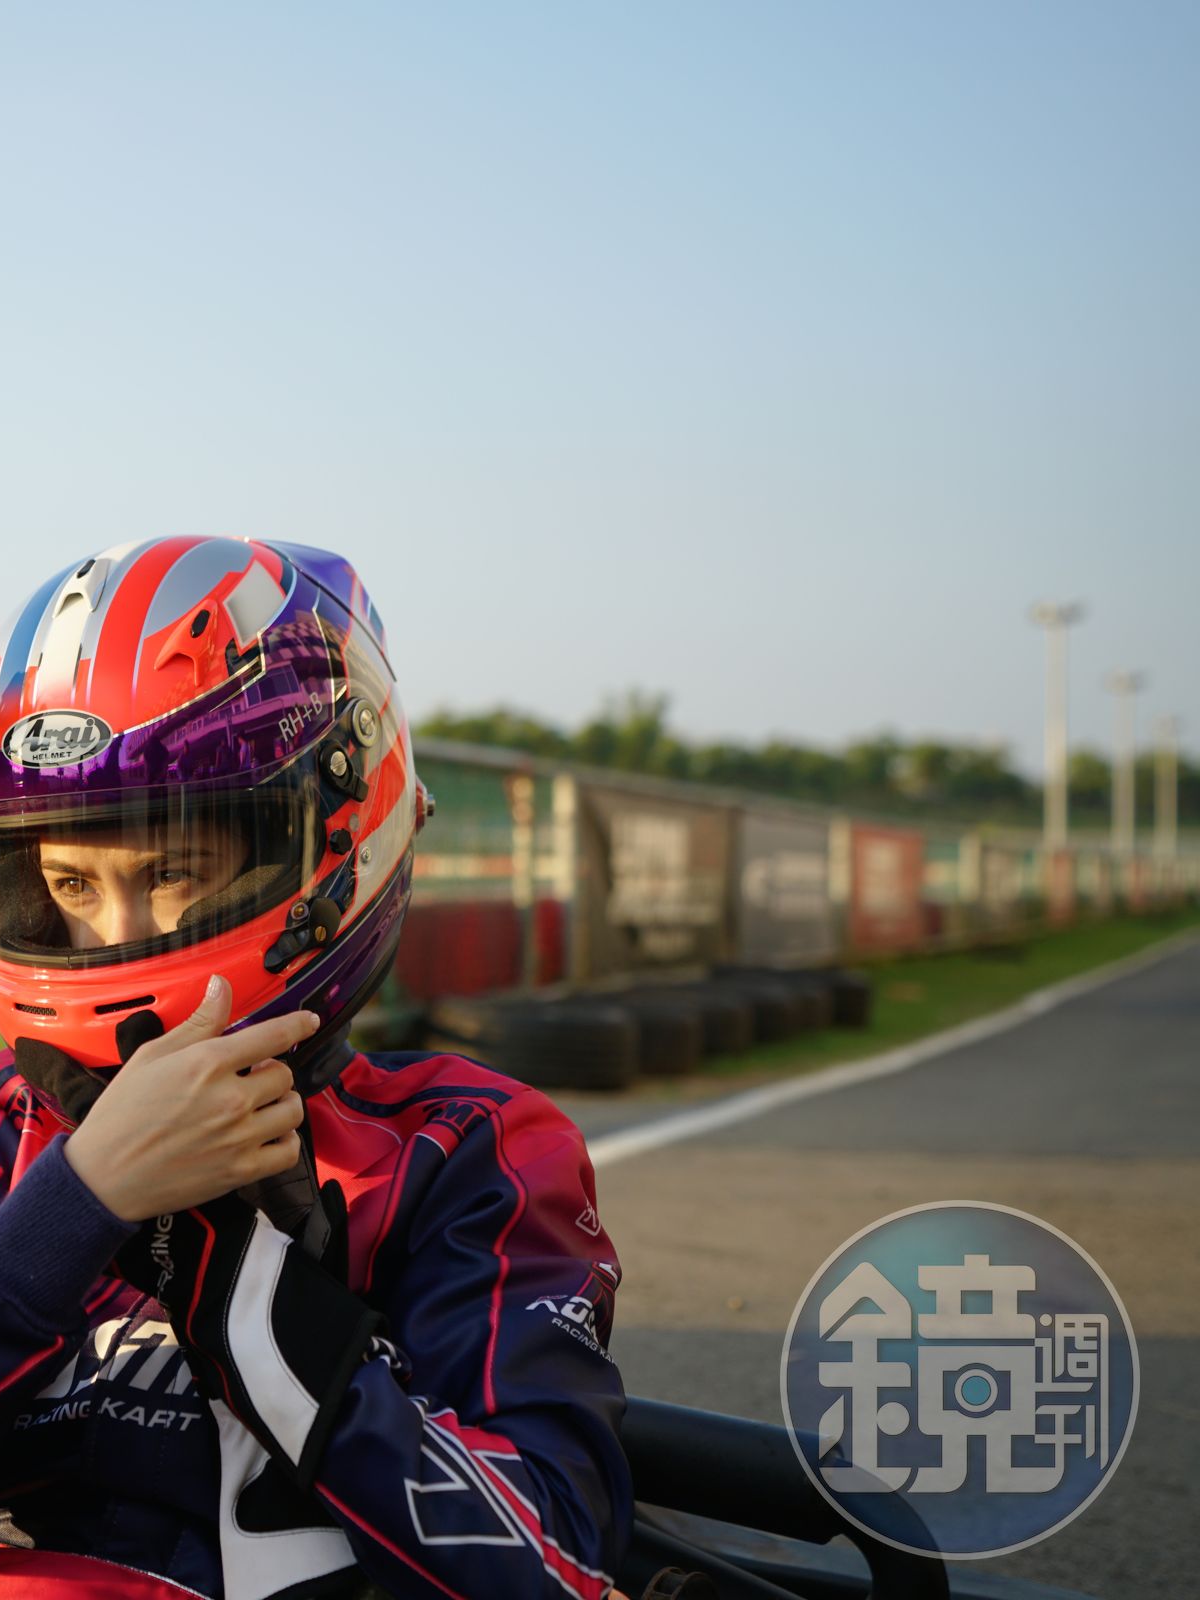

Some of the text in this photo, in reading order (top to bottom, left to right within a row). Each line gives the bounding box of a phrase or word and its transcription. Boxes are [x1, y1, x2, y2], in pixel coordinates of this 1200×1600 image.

[279, 692, 323, 742] RH+B
[22, 718, 97, 752] Arai
[32, 751, 73, 761] HELMET
[552, 1317, 599, 1352] RACING
[98, 1397, 203, 1432] KART
